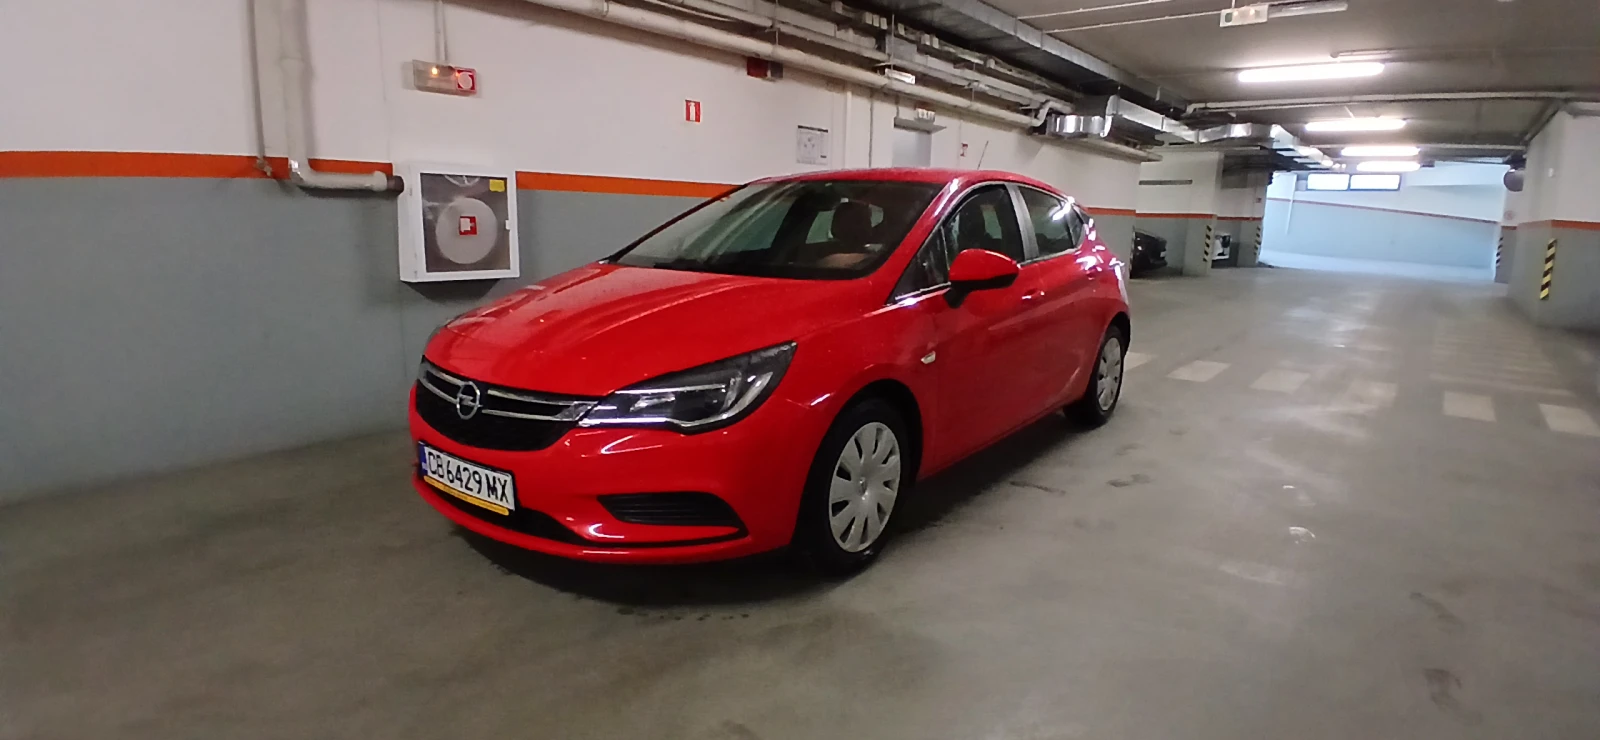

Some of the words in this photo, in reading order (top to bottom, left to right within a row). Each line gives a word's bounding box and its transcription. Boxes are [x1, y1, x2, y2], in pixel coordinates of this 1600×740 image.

[427, 451, 445, 479] CB
[446, 460, 483, 495] 6429
[485, 473, 509, 504] MX
